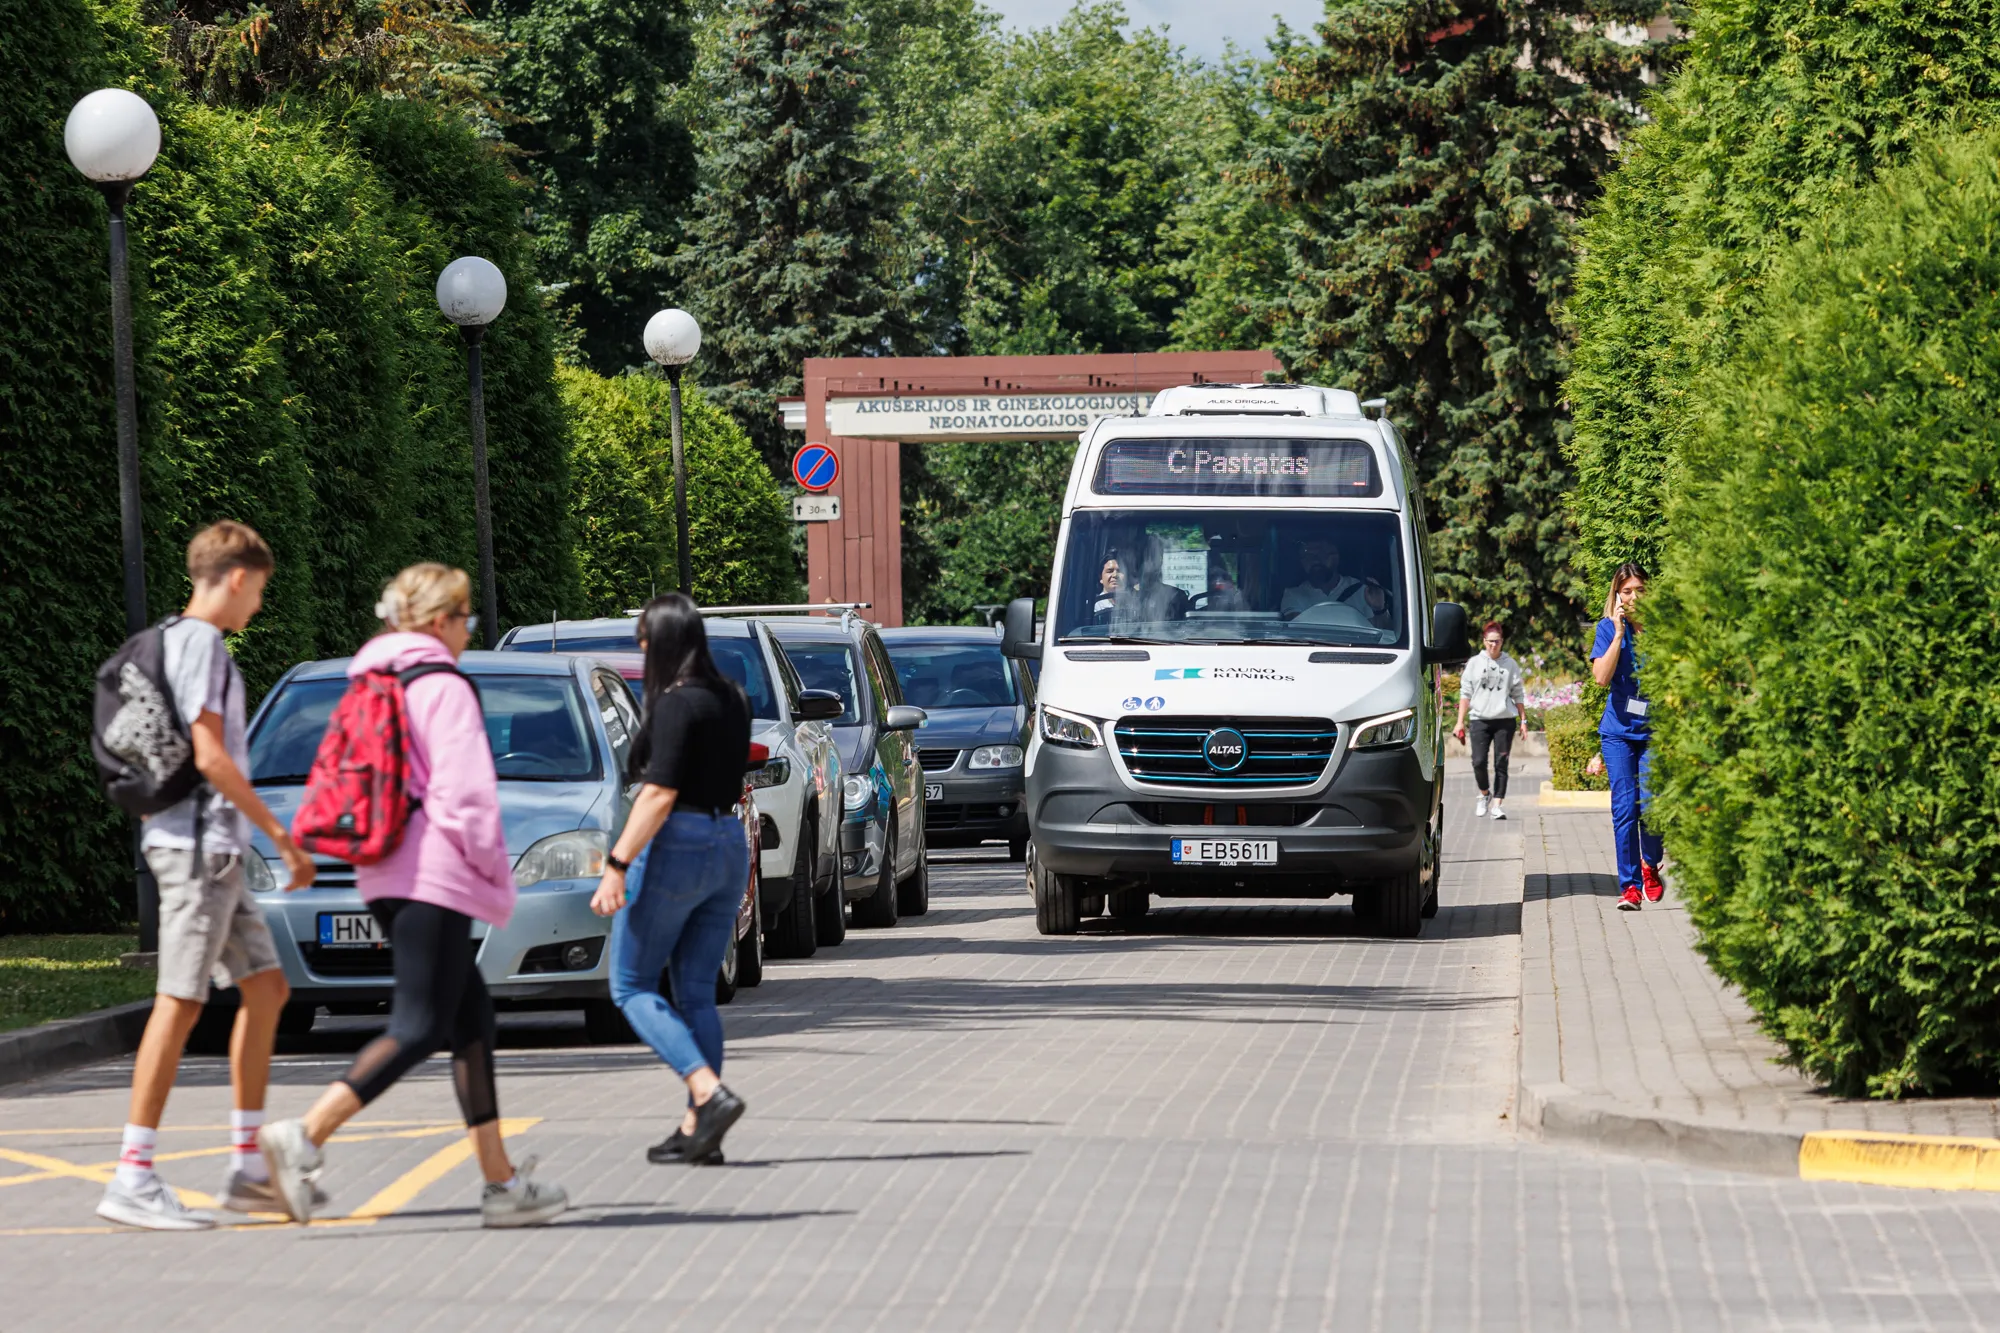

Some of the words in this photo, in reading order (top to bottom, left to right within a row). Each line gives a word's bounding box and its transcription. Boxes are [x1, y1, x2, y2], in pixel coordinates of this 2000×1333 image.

[856, 395, 967, 413] AKUŠERIJOS
[972, 399, 992, 412] IR
[997, 396, 1139, 411] GINEKOLOGIJOS
[929, 414, 1088, 429] NEONATOLOGIJOS
[1168, 450, 1186, 473] C
[1195, 450, 1308, 474] Pastatas
[1214, 673, 1295, 681] KLINIKOS
[1209, 745, 1241, 754] ALTAS
[925, 786, 940, 798] 67
[1201, 843, 1268, 860] EB5611
[336, 918, 372, 940] HN
